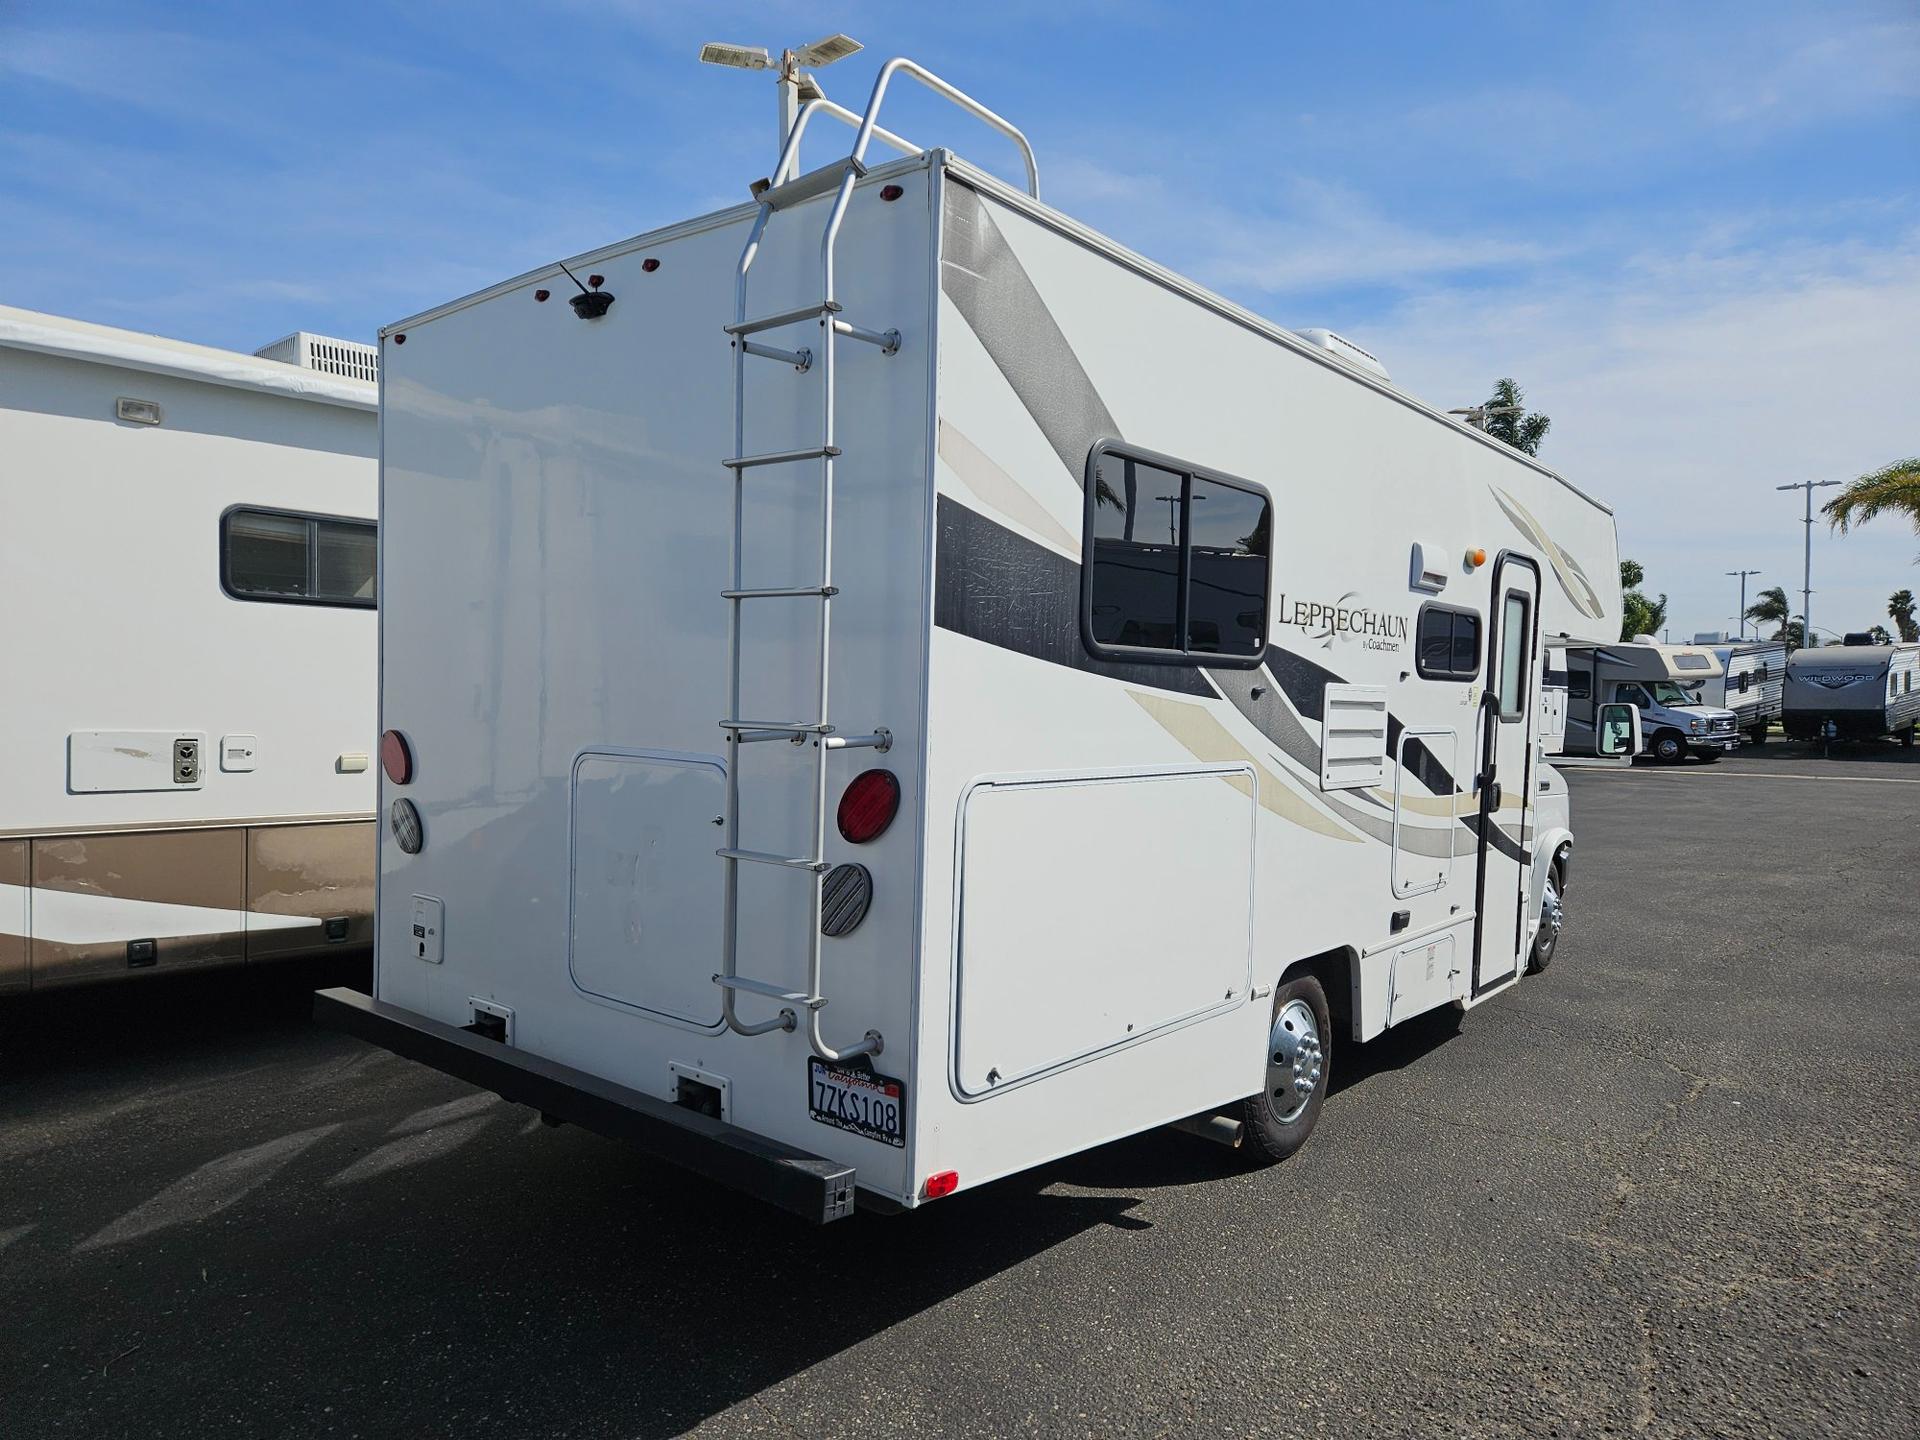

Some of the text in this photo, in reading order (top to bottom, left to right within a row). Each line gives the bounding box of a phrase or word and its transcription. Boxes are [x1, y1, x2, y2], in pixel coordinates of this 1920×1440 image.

[1278, 593, 1409, 643] LEPRECHAUN
[1368, 638, 1400, 653] Coachmen
[1798, 675, 1875, 683] WILDWOOD
[815, 1080, 898, 1133] 7ZKS108
